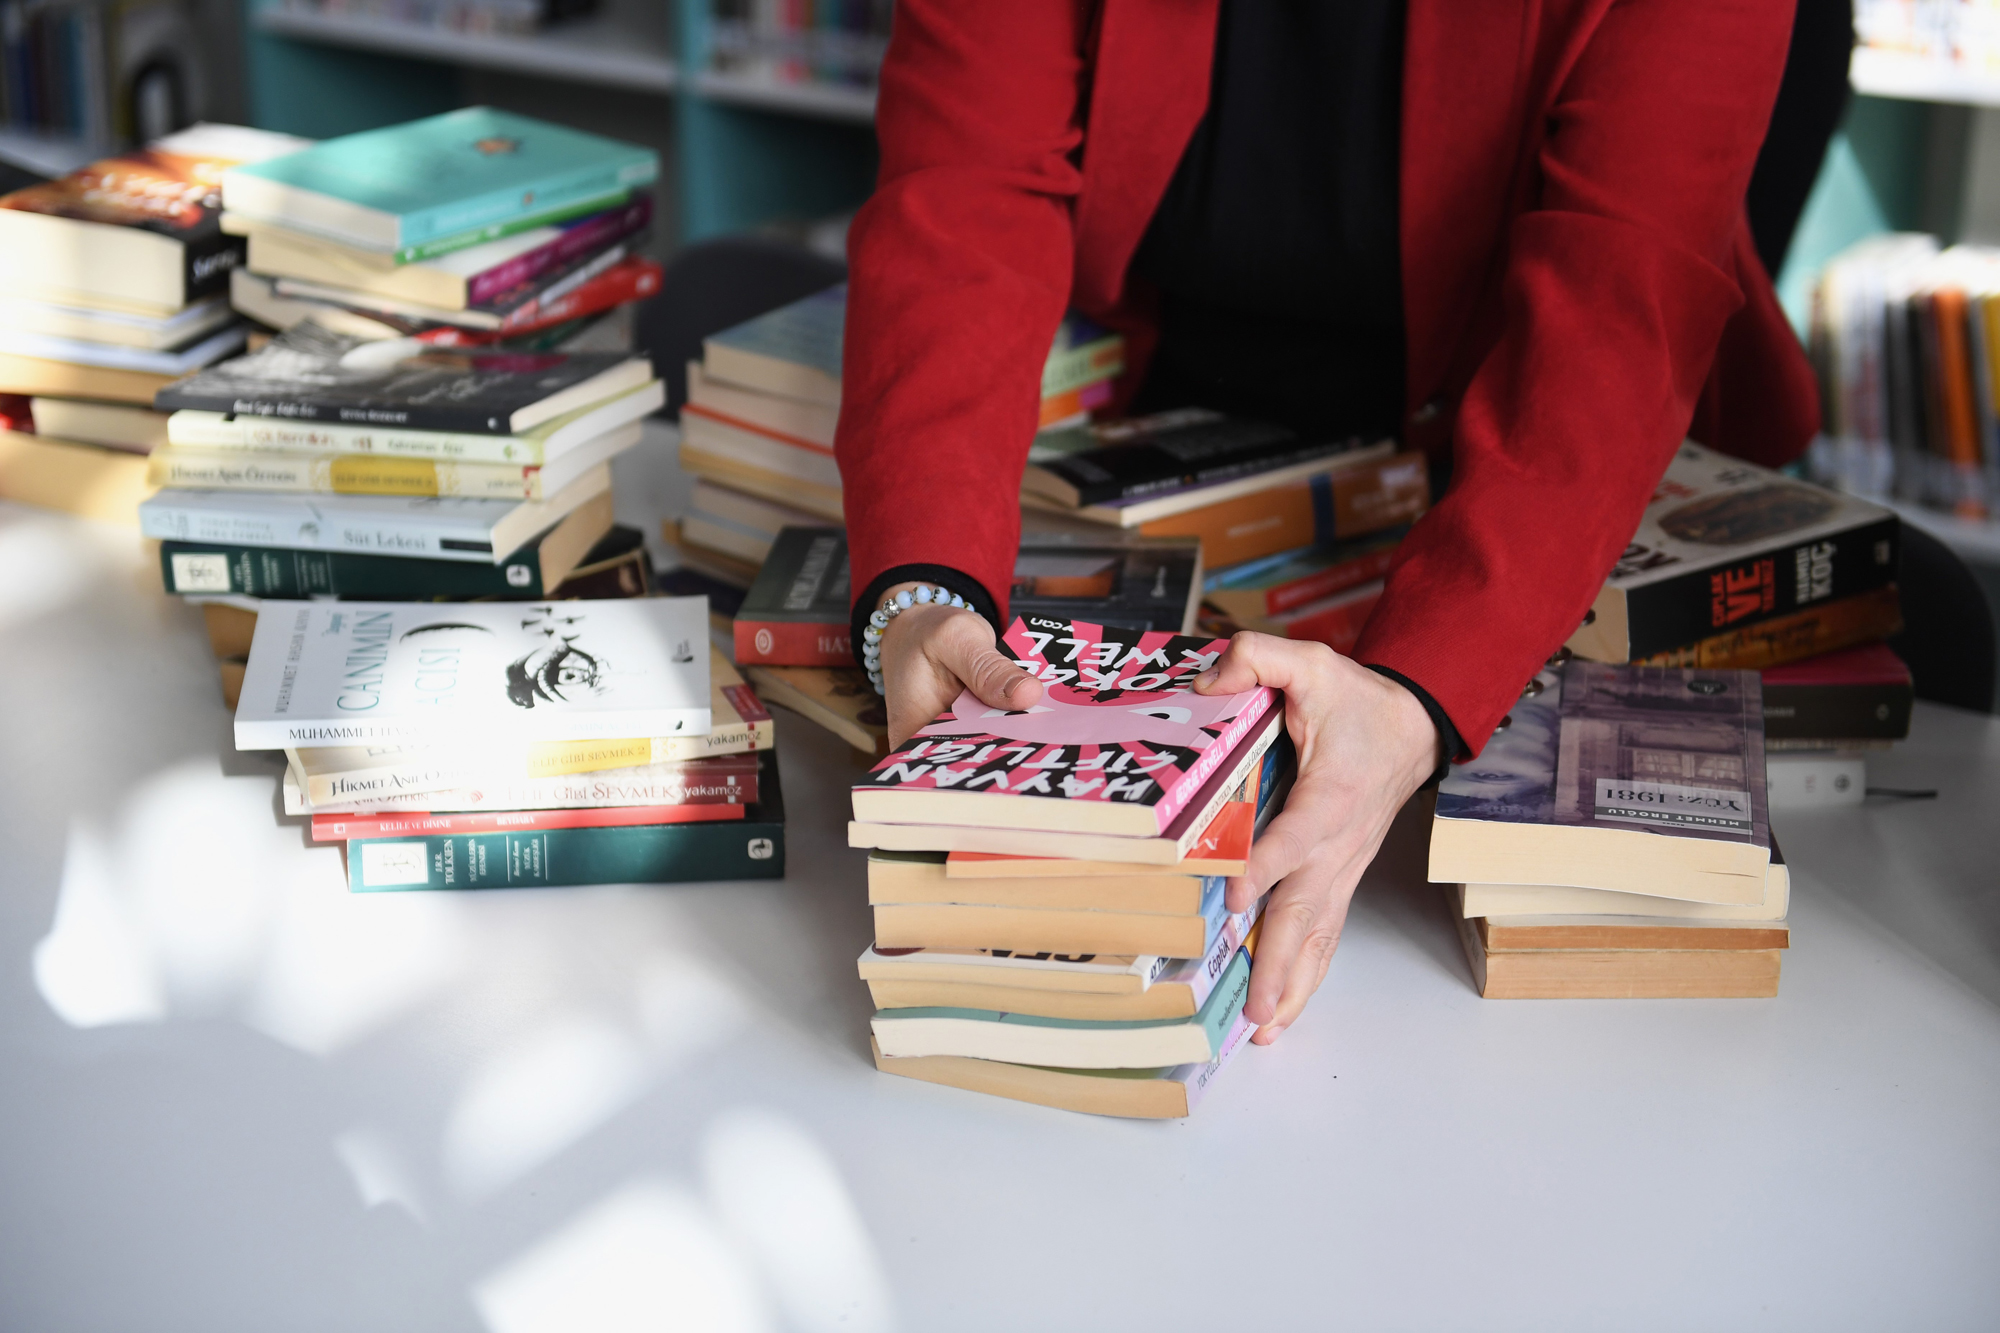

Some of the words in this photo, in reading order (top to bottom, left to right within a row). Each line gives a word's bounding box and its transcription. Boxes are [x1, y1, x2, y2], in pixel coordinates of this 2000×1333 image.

[1811, 541, 1836, 600] KOÇ
[1725, 561, 1762, 624] VE
[1030, 617, 1062, 631] can
[818, 635, 851, 654] HA
[1021, 630, 1220, 670] RWELL
[336, 610, 394, 712] CANIMIN
[707, 730, 762, 747] yakamoz
[1199, 743, 1224, 778] ORWELL
[1225, 716, 1248, 751] HAYVAN
[588, 747, 637, 762] SEVMEK
[637, 746, 646, 756] 2
[331, 776, 385, 797] HİKMET
[875, 762, 1154, 800] HAYVAN
[592, 782, 676, 801] SEVMEK
[684, 783, 742, 798] yakamoz
[1605, 788, 1667, 804] 1981
[422, 818, 452, 830] DİMNE
[1607, 808, 1670, 820] EROĞLU
[1675, 815, 1740, 827] MEHMET
[443, 838, 455, 885] TOLKIEN
[1207, 936, 1231, 981] Çöplük
